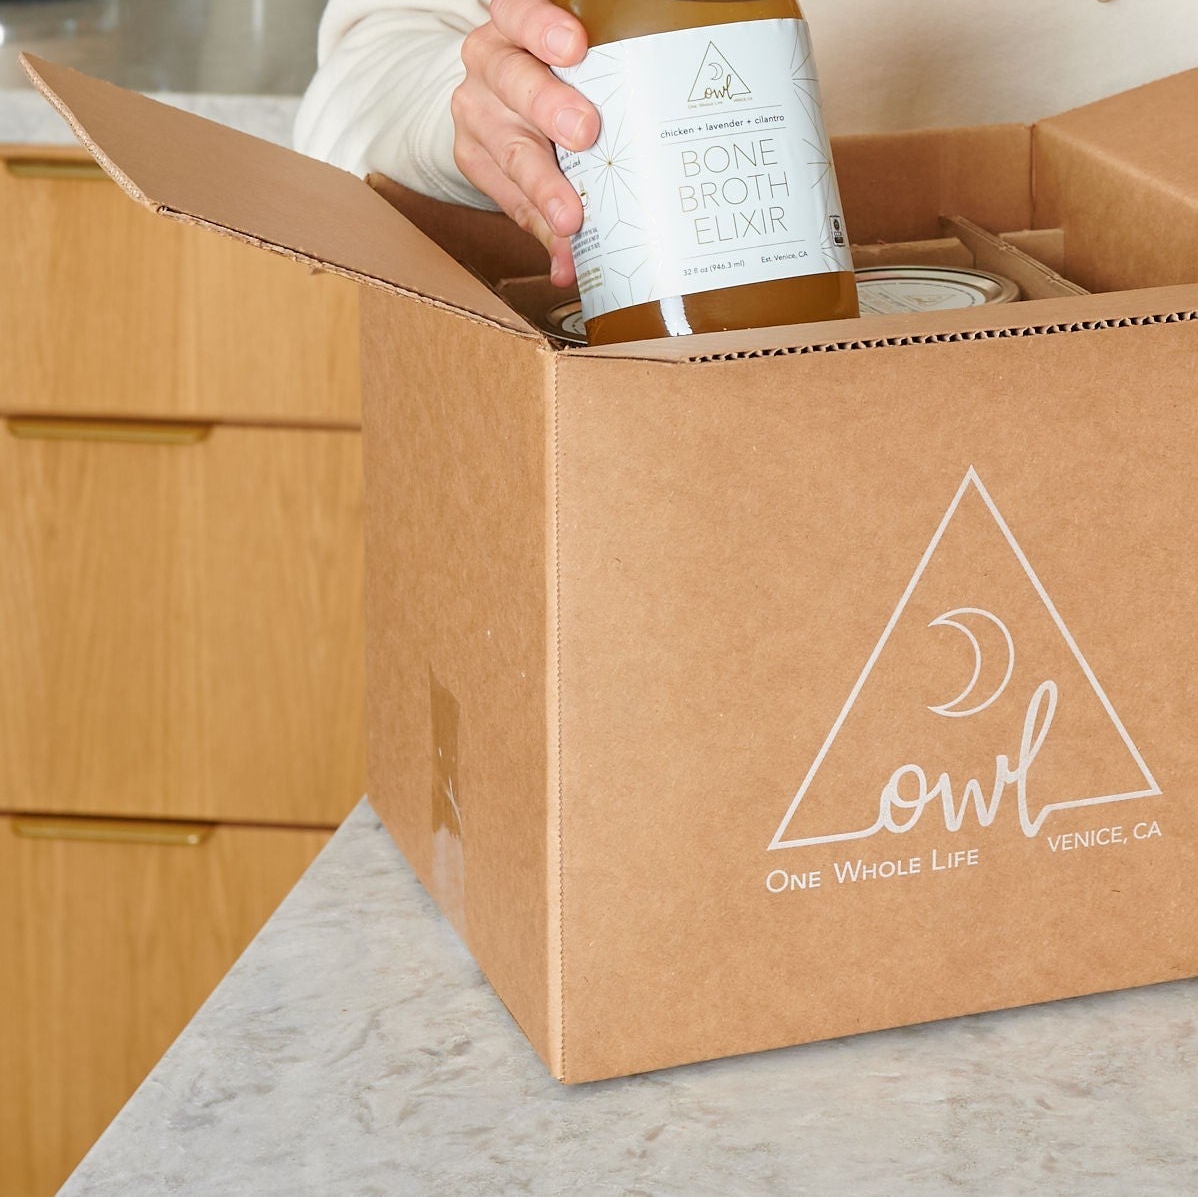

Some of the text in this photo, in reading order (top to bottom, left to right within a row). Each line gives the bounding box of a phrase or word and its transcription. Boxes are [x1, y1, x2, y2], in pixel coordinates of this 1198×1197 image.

[704, 73, 733, 100] owl
[660, 126, 695, 139] chicken
[705, 119, 744, 131] lavender
[754, 114, 785, 124] cilantro
[681, 138, 778, 177] BONE
[678, 171, 790, 213] BROTH
[694, 206, 788, 245] ELIXIR
[683, 268, 692, 276] 32
[733, 259, 745, 268] ml)
[761, 255, 772, 263] Est.
[773, 252, 797, 261] Venice,
[880, 680, 1058, 838] owl
[1047, 820, 1162, 853] VENICE, CA
